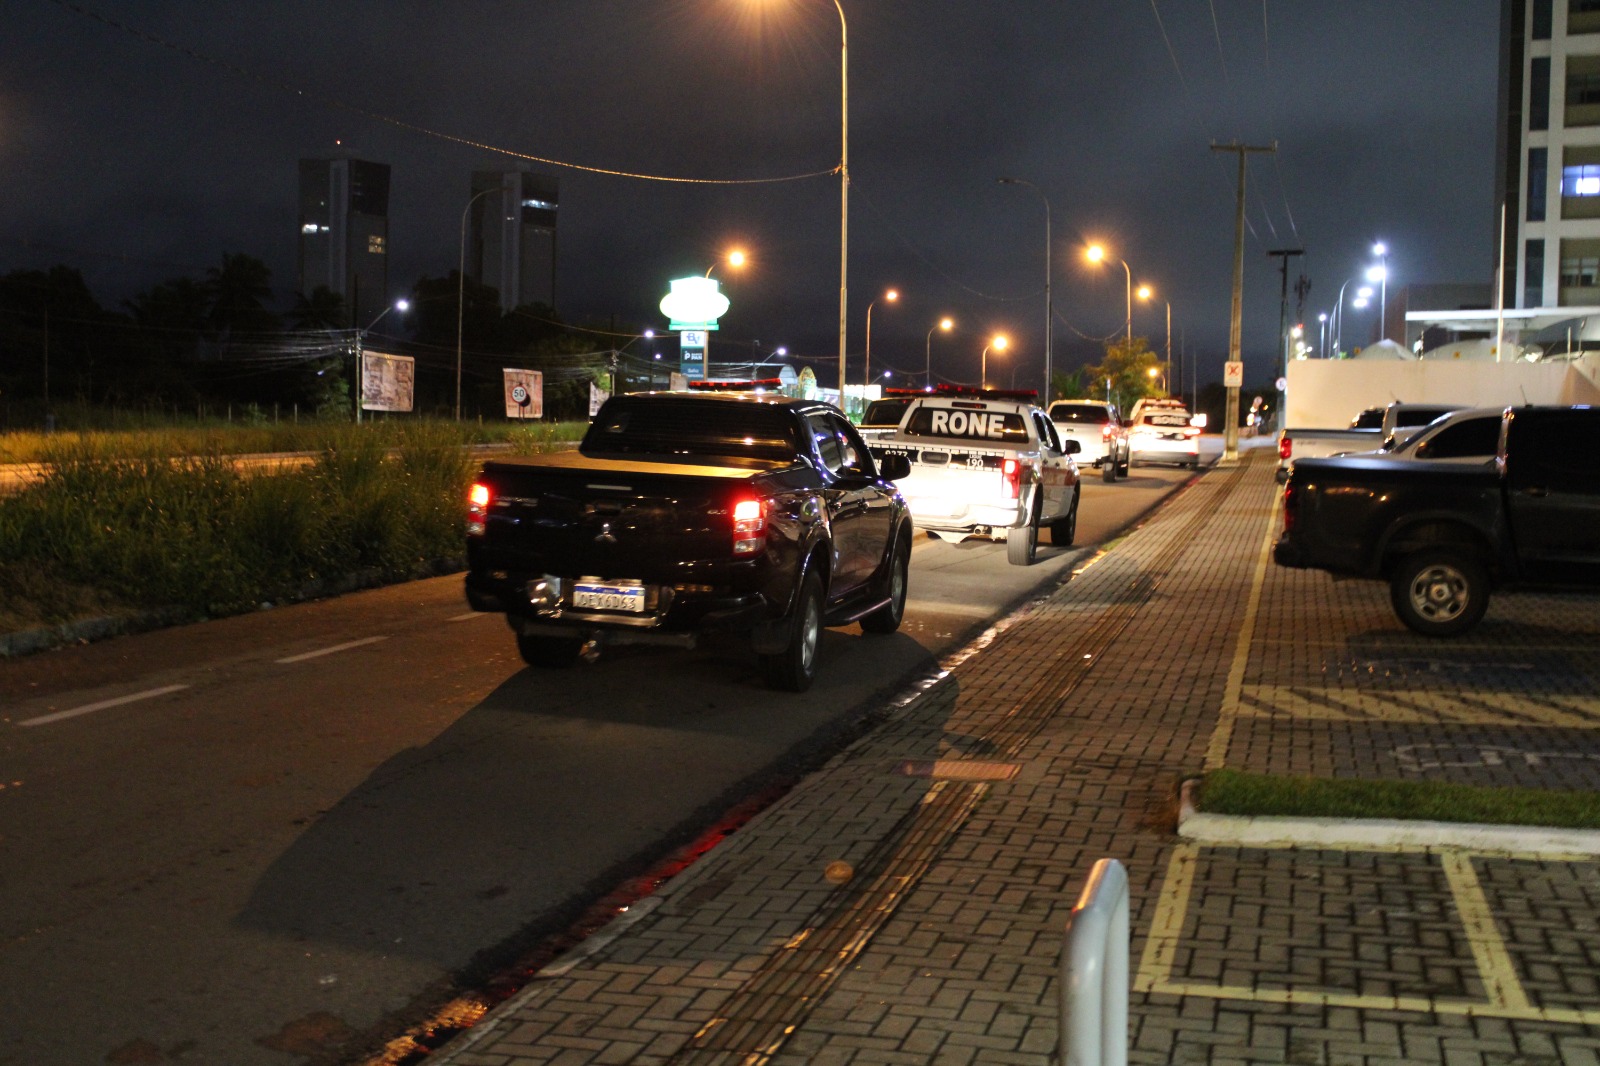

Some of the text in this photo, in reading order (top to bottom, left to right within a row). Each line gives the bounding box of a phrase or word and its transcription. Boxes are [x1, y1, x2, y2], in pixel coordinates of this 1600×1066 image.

[514, 389, 525, 398] 50
[931, 410, 1006, 438] RONE
[1151, 415, 1187, 425] RONE
[966, 458, 984, 467] 190
